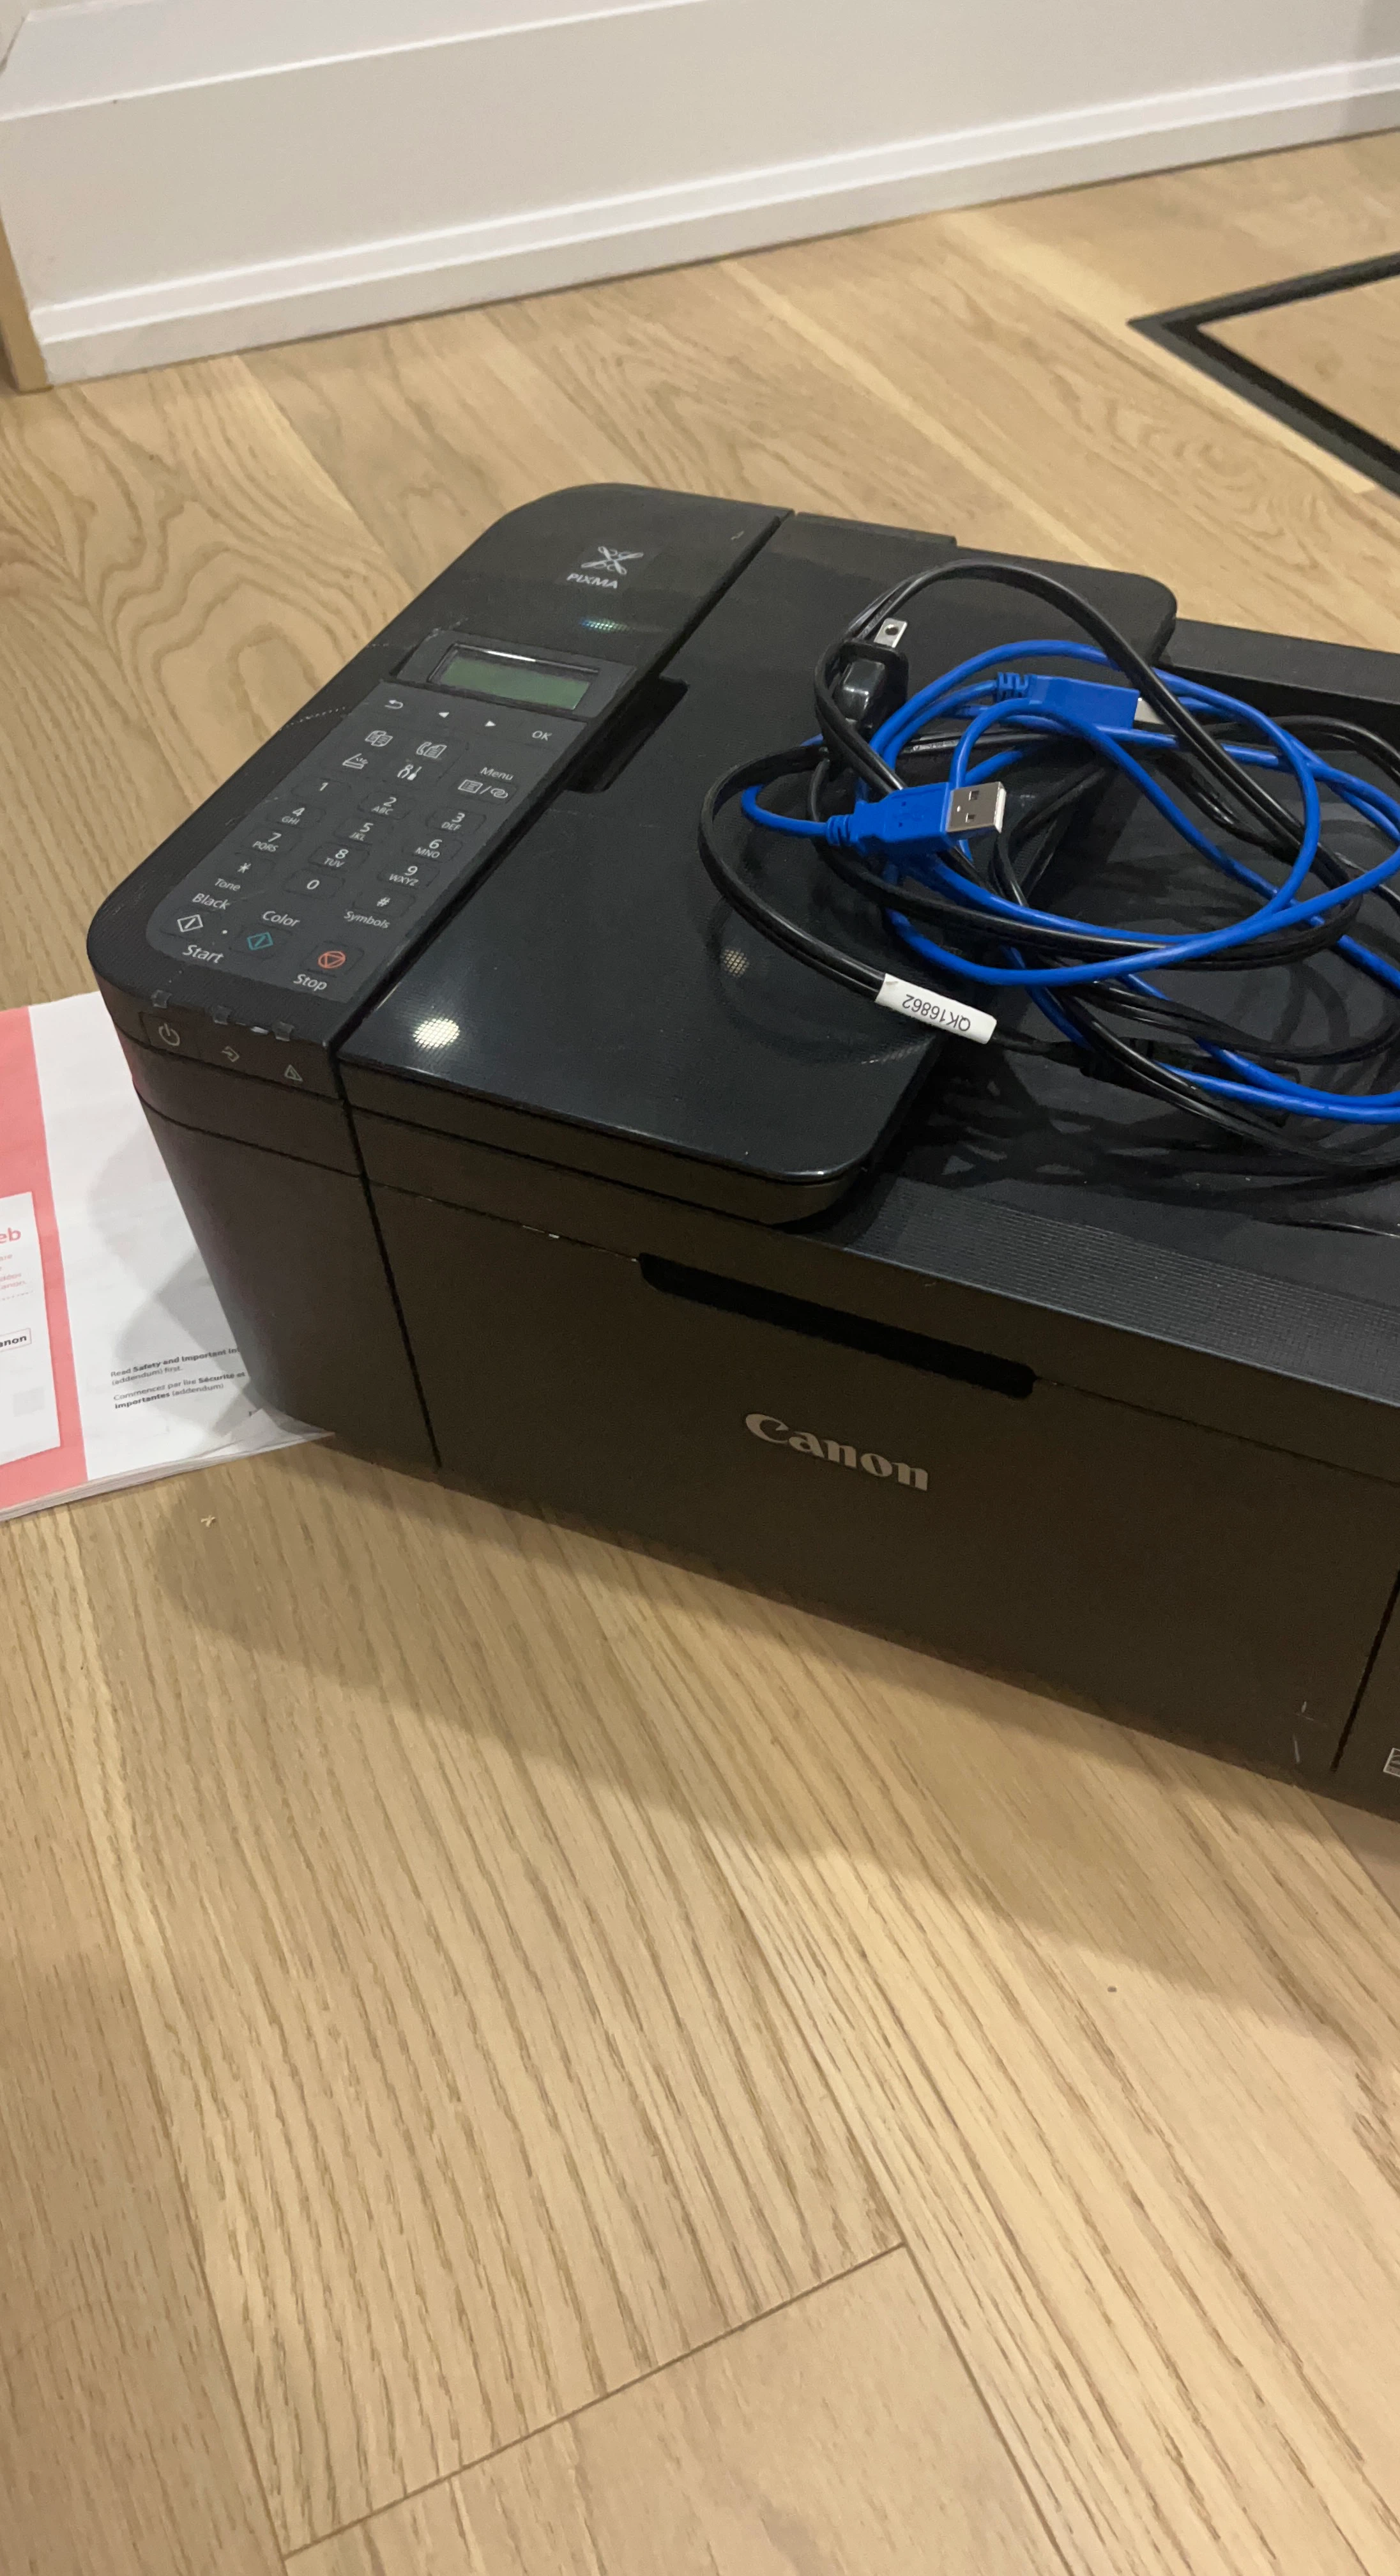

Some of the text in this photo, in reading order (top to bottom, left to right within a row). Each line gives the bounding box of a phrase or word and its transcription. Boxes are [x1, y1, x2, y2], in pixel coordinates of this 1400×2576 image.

[566, 572, 618, 589] PIXMA
[531, 730, 553, 741] OK
[480, 767, 514, 781] Menu
[319, 782, 330, 792] 1
[383, 797, 397, 808] 2
[292, 807, 306, 817] 4
[370, 806, 394, 816] ABC
[281, 815, 301, 825] GHI
[452, 812, 466, 824] 3
[360, 822, 374, 832] 5
[441, 822, 462, 831] DEF
[268, 832, 282, 843] 7
[252, 840, 279, 853] PQRS
[429, 839, 443, 849] 6
[335, 848, 349, 859] 8
[415, 847, 441, 859] MNO
[323, 857, 346, 868] TUV
[404, 865, 419, 876] 9
[215, 878, 241, 892] Tone
[306, 879, 321, 891] 0
[388, 873, 419, 887] WXYZ
[192, 893, 231, 910] Black
[262, 910, 301, 928] Color
[344, 910, 391, 929] Symbols
[183, 944, 224, 964] Start
[293, 973, 328, 992] Stop
[901, 993, 971, 1032] QK16862
[110, 1368, 132, 1377] Read
[133, 1361, 161, 1373] Safety
[163, 1356, 179, 1365] and
[181, 1349, 226, 1362] Important
[112, 1368, 163, 1386] (addendum)
[172, 1383, 224, 1397] (addendum)
[745, 1413, 929, 1492] Canon
